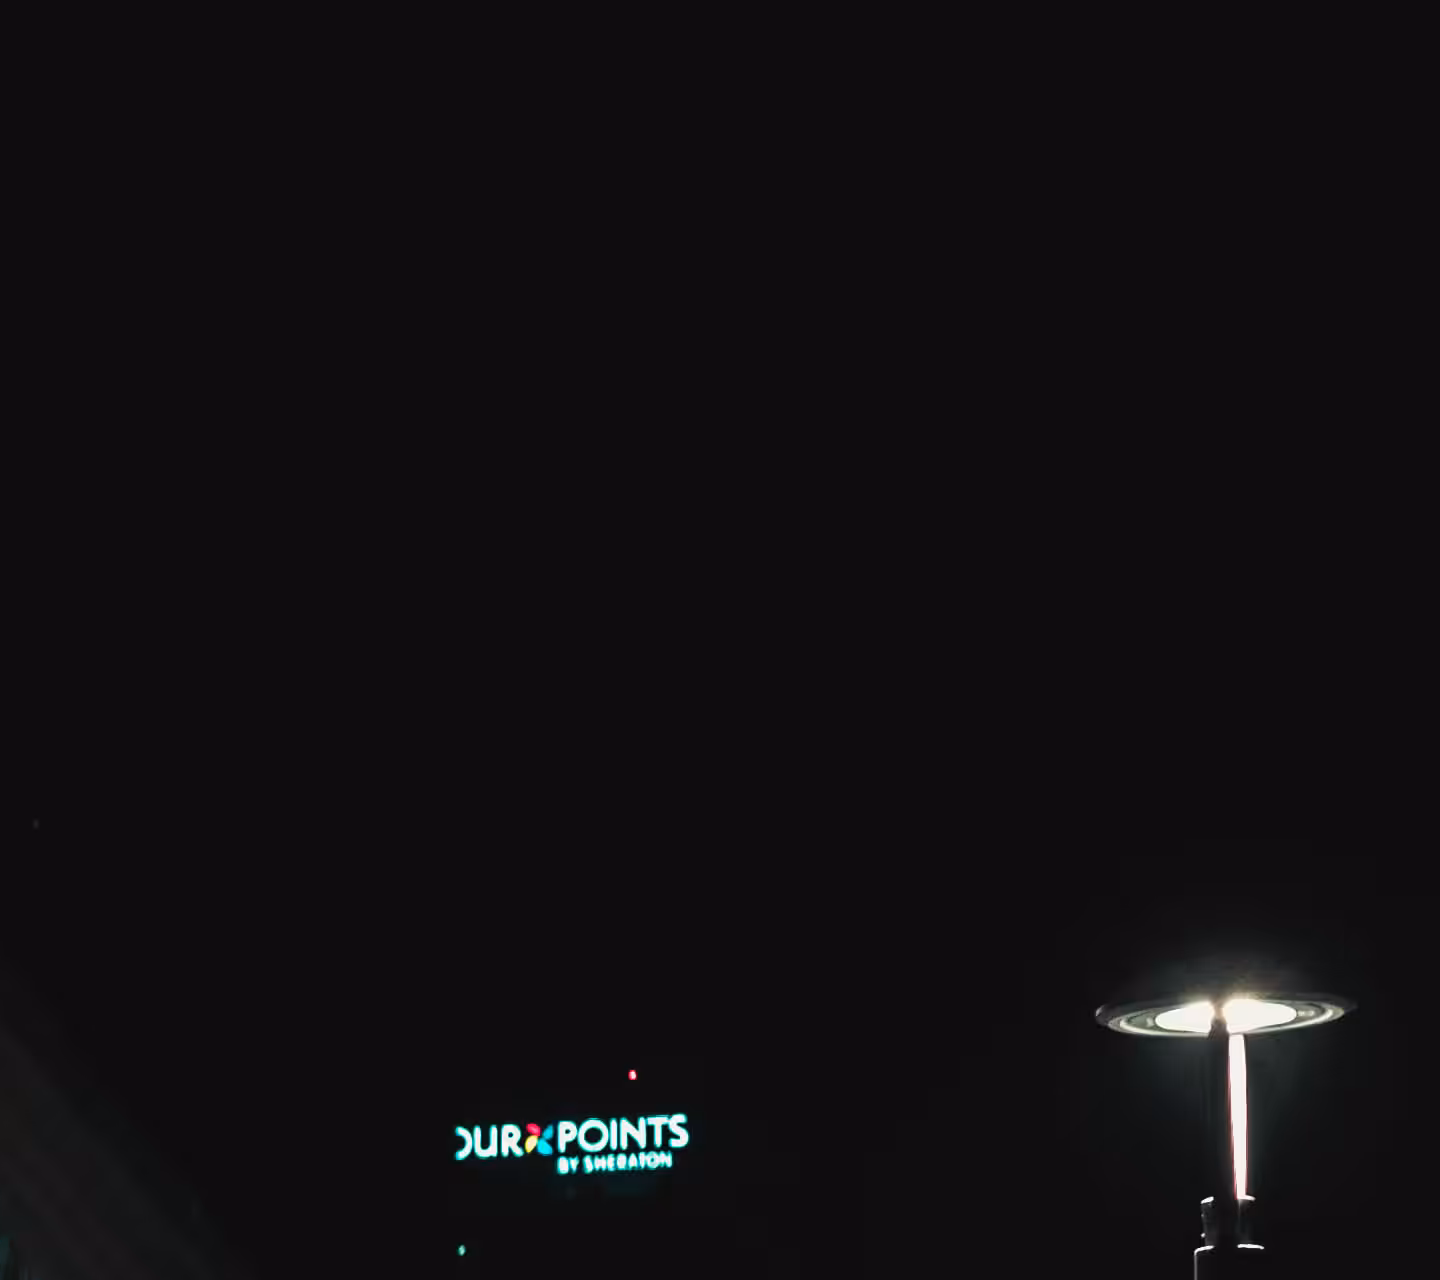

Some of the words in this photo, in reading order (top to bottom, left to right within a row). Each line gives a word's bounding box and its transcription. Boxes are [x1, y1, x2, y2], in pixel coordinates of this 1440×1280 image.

[455, 1124, 524, 1160] OUR
[557, 1114, 690, 1153] POINTS
[557, 1156, 580, 1175] BY
[583, 1151, 674, 1174] SHERATON
